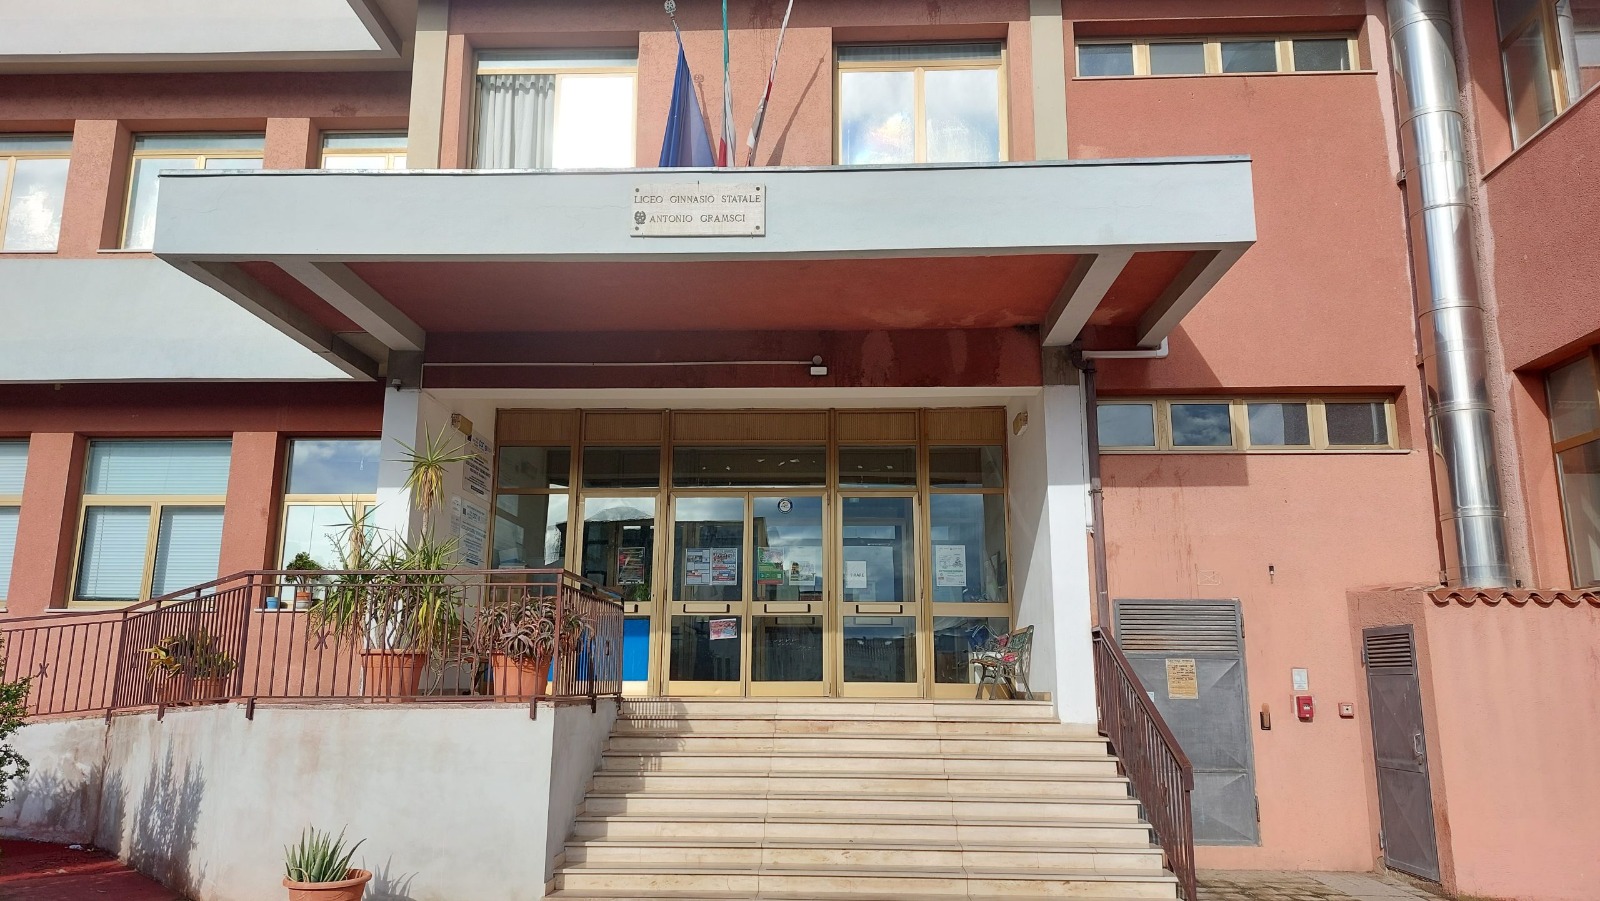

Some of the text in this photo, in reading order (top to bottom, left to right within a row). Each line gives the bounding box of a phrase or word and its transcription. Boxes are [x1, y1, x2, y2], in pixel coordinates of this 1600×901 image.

[634, 194, 762, 204] LICEO GINNASIO STATALE
[649, 214, 746, 223] ANTONIO GRAMSCI
